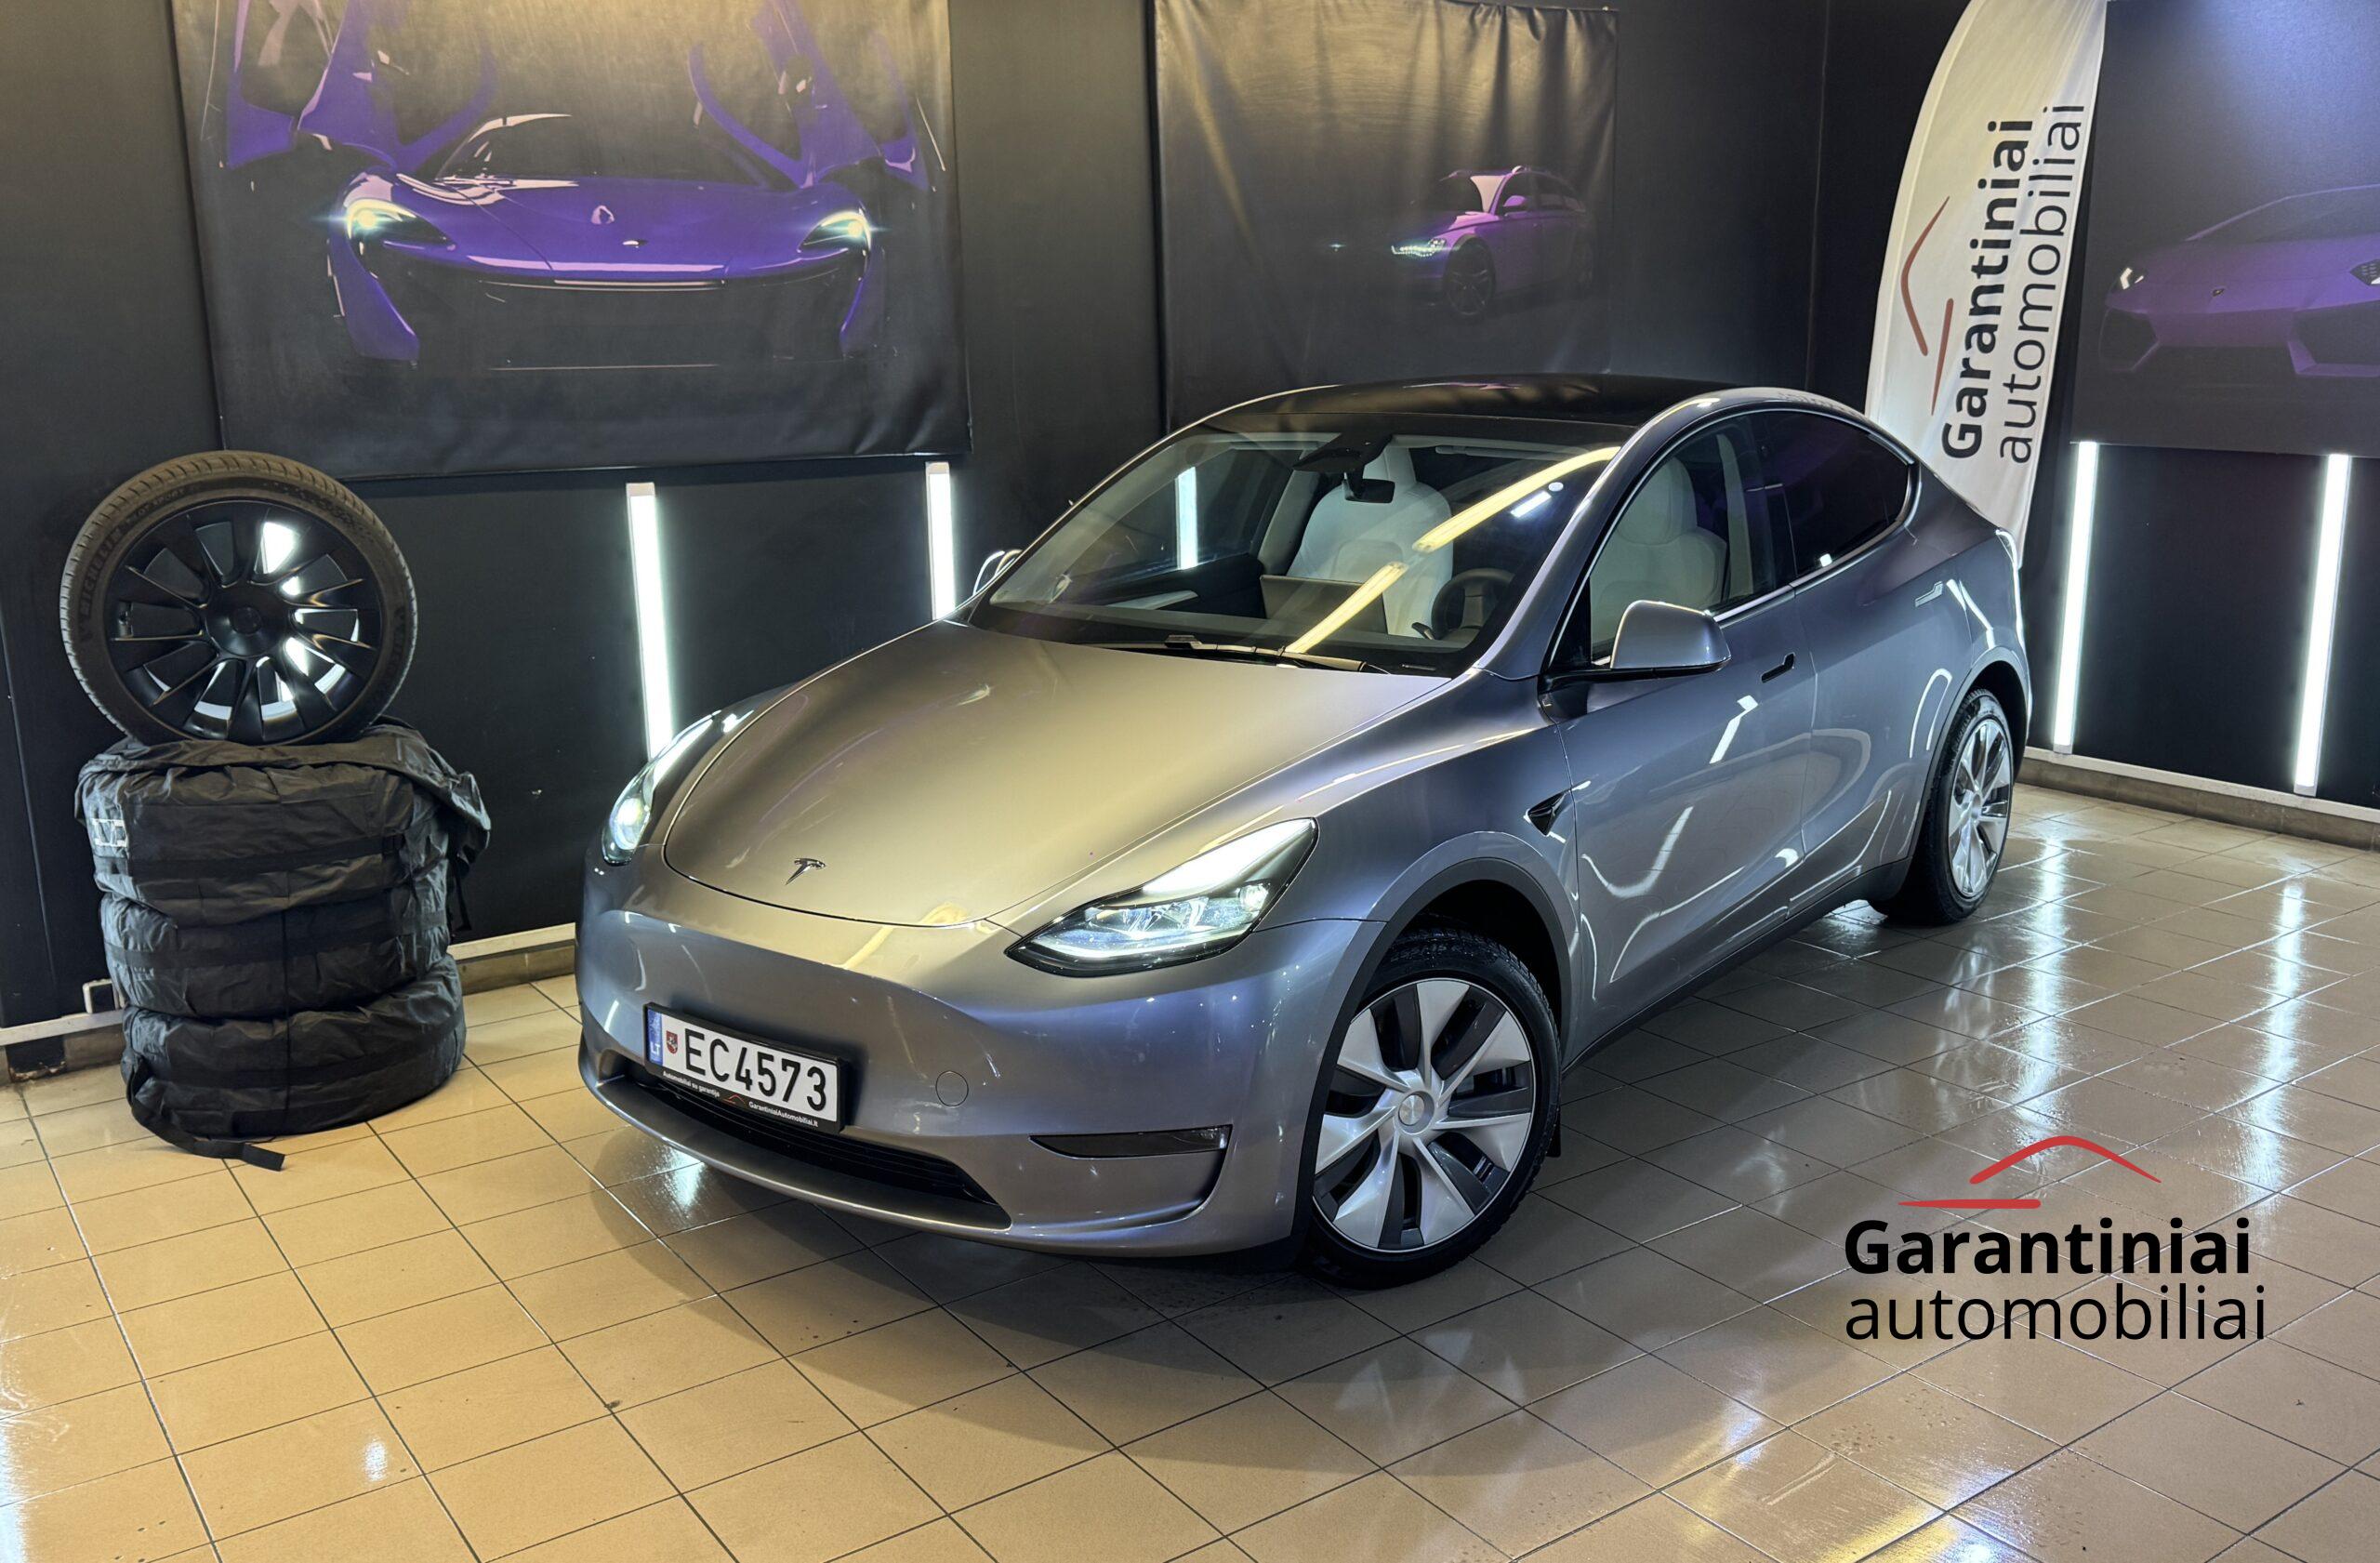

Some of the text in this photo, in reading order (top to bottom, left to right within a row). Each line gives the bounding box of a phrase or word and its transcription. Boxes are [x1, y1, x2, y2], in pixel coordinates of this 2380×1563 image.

[1942, 120, 2033, 459] Garantiniai
[1999, 105, 2084, 464] automobiliai
[650, 1040, 661, 1056] LT
[684, 1027, 827, 1112] EC4573
